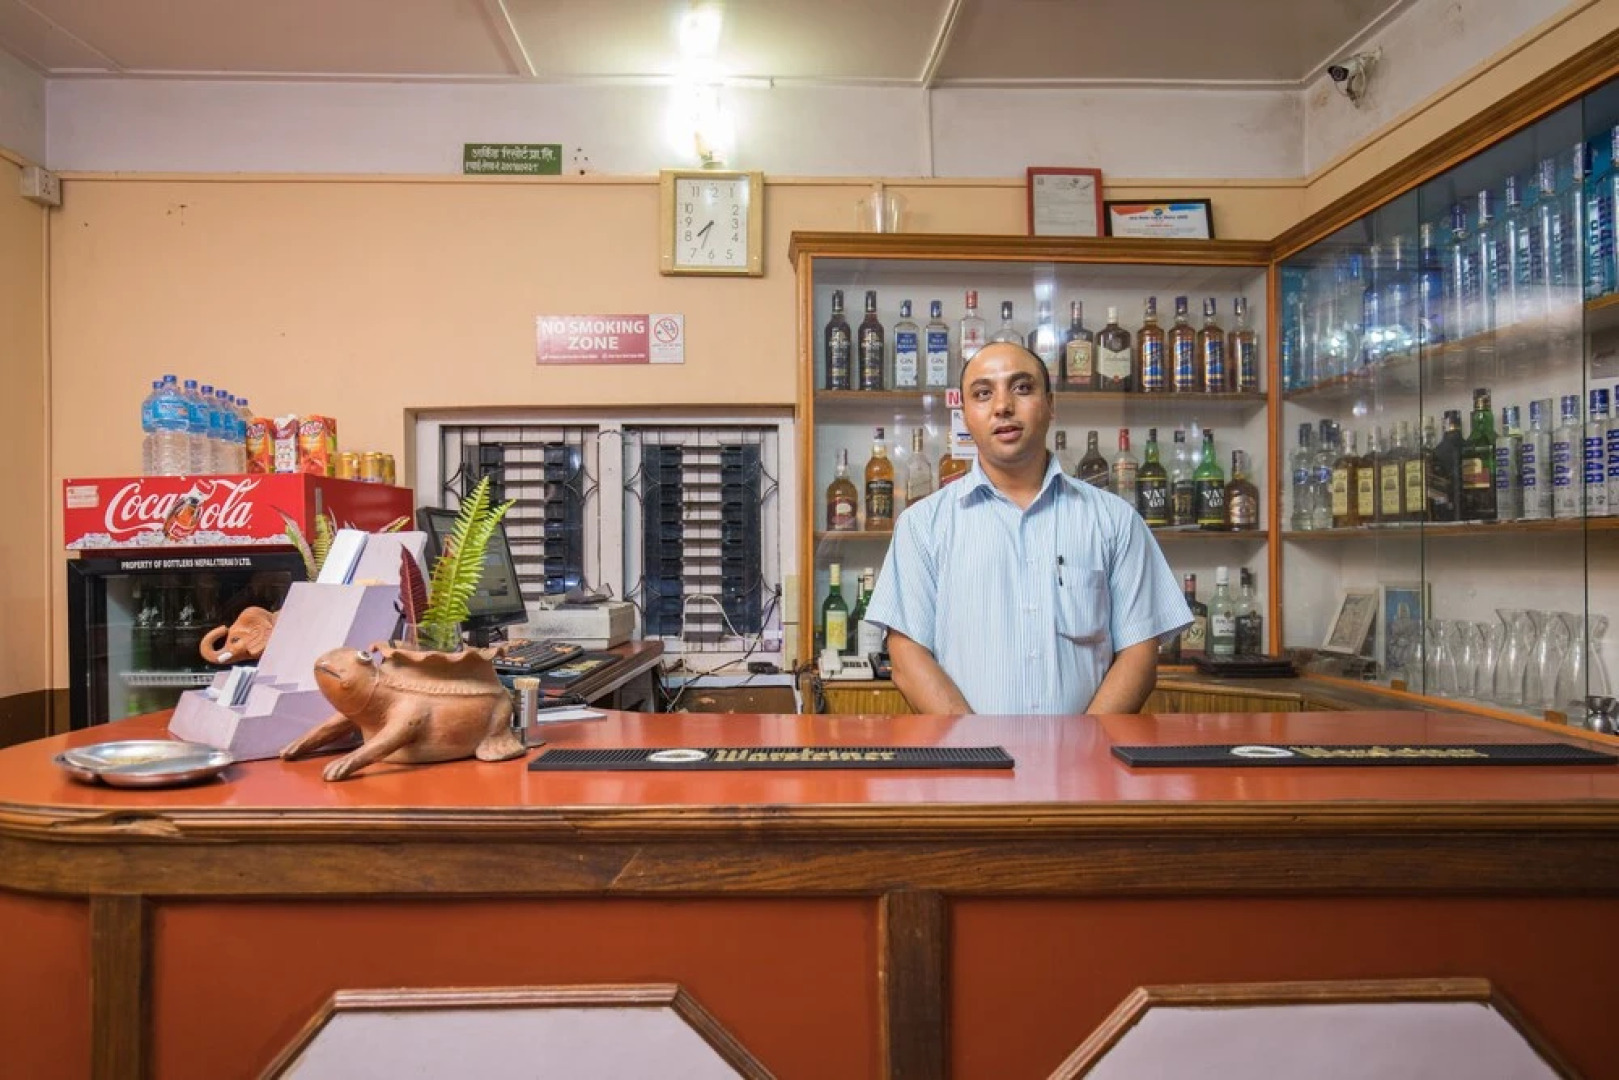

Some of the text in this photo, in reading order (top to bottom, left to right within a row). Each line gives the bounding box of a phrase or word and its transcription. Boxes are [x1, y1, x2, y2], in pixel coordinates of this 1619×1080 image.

[692, 186, 700, 197] 11
[685, 203, 694, 214] 10
[732, 204, 739, 215] 2
[685, 217, 692, 227] 9
[732, 218, 739, 229] 3
[685, 231, 692, 242] 8
[732, 233, 739, 242] 4
[690, 248, 697, 258] 7
[708, 250, 715, 260] 6
[726, 249, 733, 260] 5
[541, 320, 645, 334] NO SMOKING
[568, 336, 619, 350] ZONE
[1522, 444, 1536, 486] 8848
[1554, 442, 1570, 486] 8848
[1584, 437, 1604, 483] 8848
[1143, 488, 1166, 499] VAT
[1202, 488, 1224, 499] VAT
[121, 560, 153, 570] PROPERTY
[154, 560, 162, 569] OF
[163, 559, 193, 568] BOTTLERS
